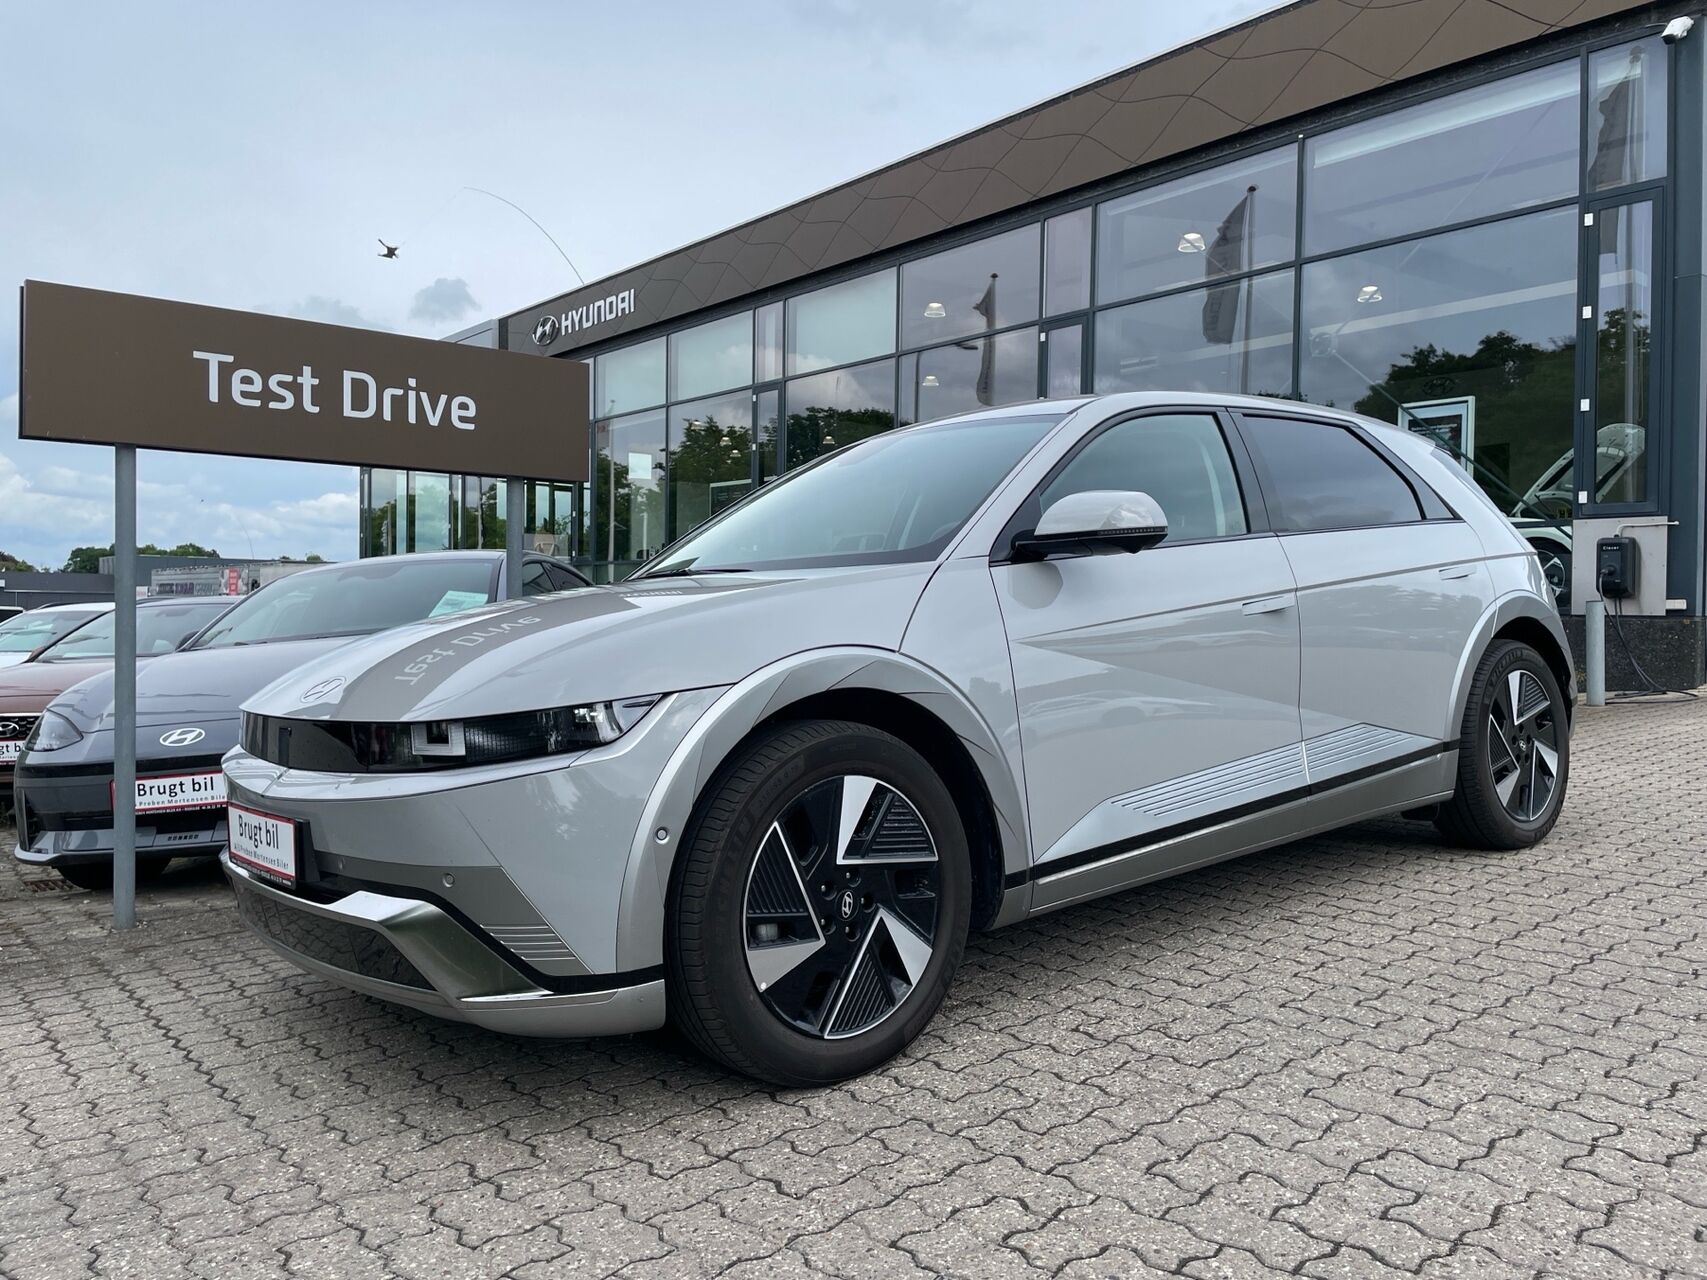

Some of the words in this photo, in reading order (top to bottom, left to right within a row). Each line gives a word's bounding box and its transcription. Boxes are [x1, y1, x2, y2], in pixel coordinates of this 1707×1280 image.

[561, 288, 635, 336] HYUNDAI
[193, 350, 320, 414] Test
[343, 370, 477, 431] Drive
[137, 780, 186, 798] Brugt
[192, 776, 214, 792] bil
[210, 793, 226, 801] Bile
[238, 813, 263, 849] Brugt
[265, 820, 280, 850] bil
